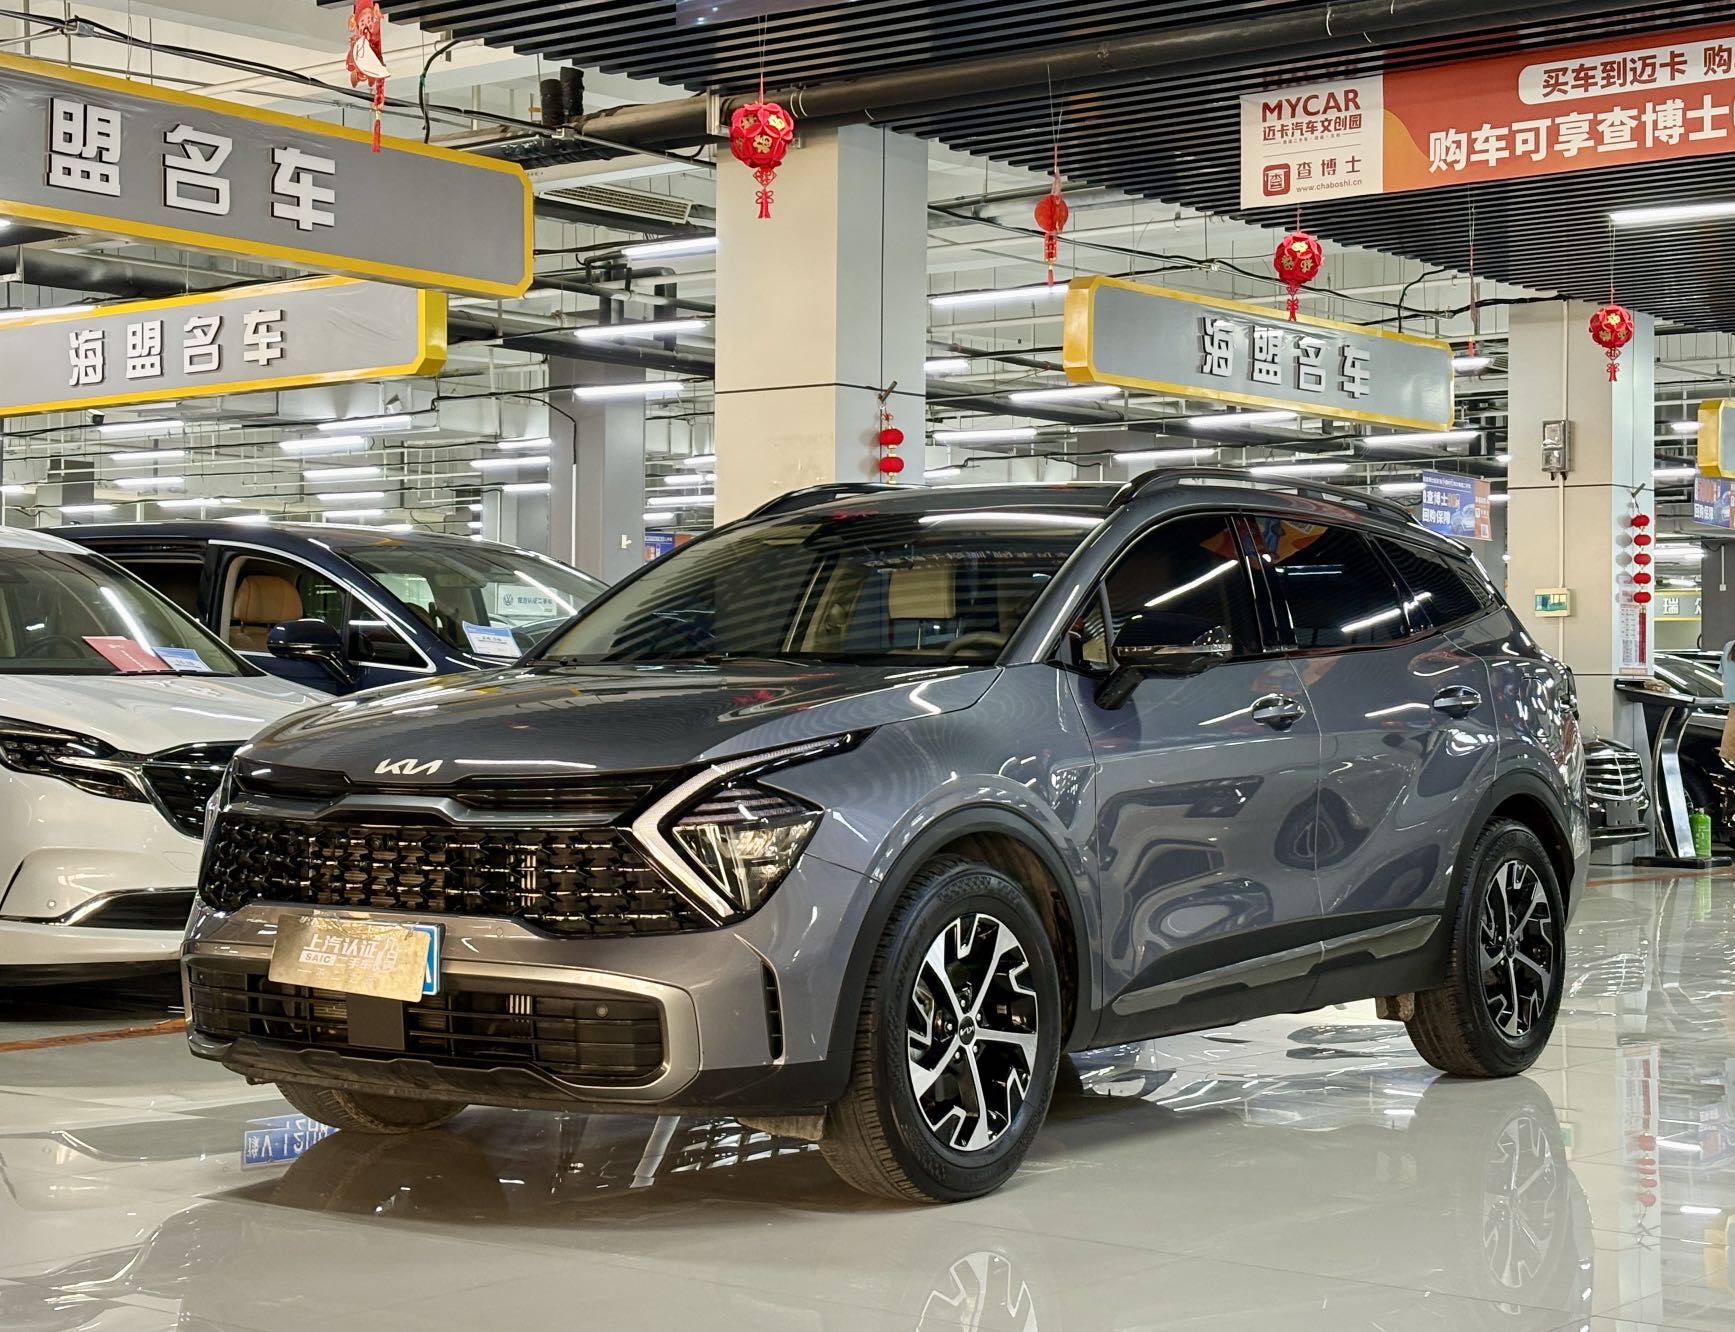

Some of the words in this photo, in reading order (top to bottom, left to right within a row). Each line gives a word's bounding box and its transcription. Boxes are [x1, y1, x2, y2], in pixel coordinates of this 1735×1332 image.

[1542, 50, 1688, 98] 买车到迈卡
[1704, 44, 1735, 76] 购
[1262, 88, 1361, 123] MYCAR
[1262, 113, 1362, 142] 迈卡汽车文创园
[1429, 94, 1735, 173] 购车可享查博士
[47, 97, 336, 231] 盟名车
[1296, 155, 1362, 180] 查博士
[1296, 178, 1362, 193] www.chaboshi.cn
[69, 309, 285, 386] 海盟名车
[1200, 316, 1371, 399] 海盟名车
[374, 758, 443, 775] KIA
[303, 933, 380, 959] 上汽认证
[305, 952, 332, 964] SAIC
